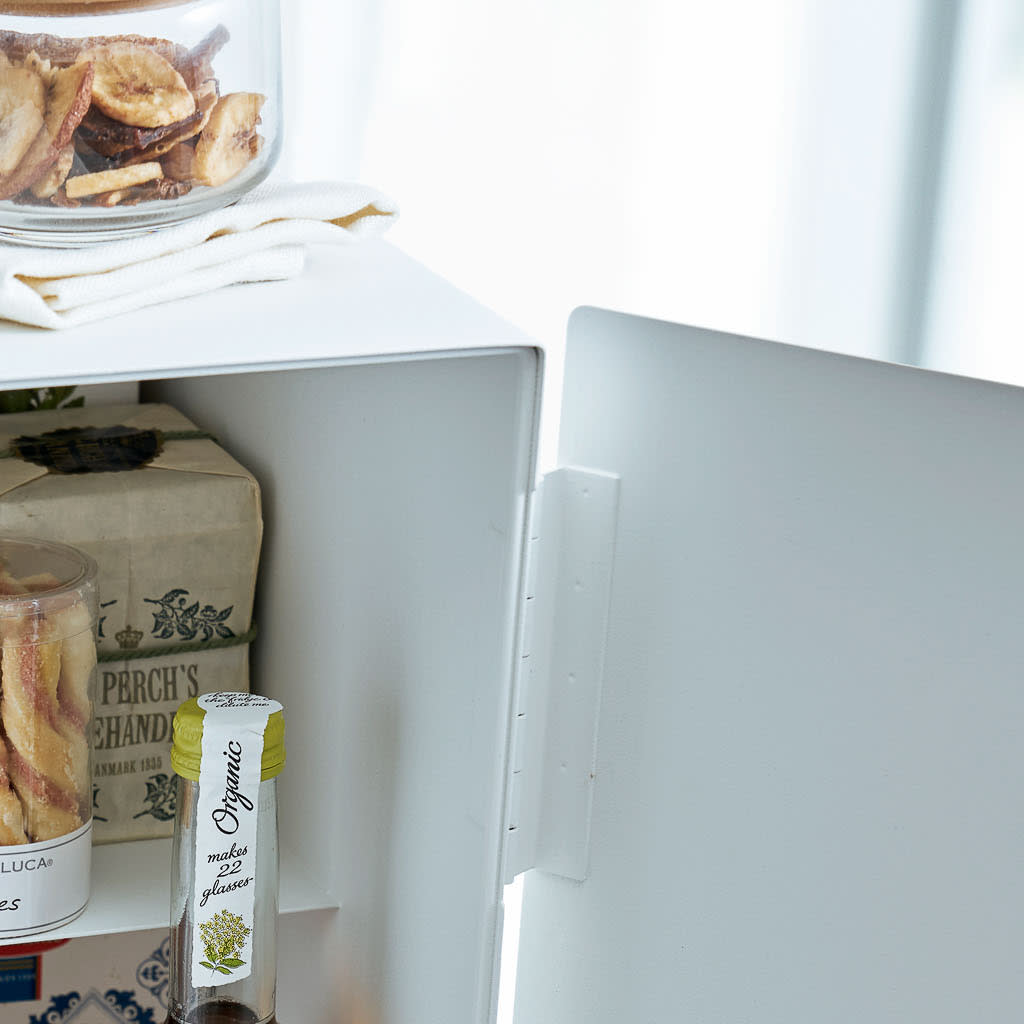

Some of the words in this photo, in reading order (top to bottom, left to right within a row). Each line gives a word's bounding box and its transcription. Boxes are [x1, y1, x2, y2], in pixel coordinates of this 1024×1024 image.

[102, 664, 199, 705] PERCH'S
[93, 712, 176, 750] EHAND
[94, 760, 137, 778] ANMARK
[211, 740, 254, 835] Organic
[207, 842, 248, 863] makes
[216, 860, 242, 878] 22
[199, 877, 254, 907] glasses
